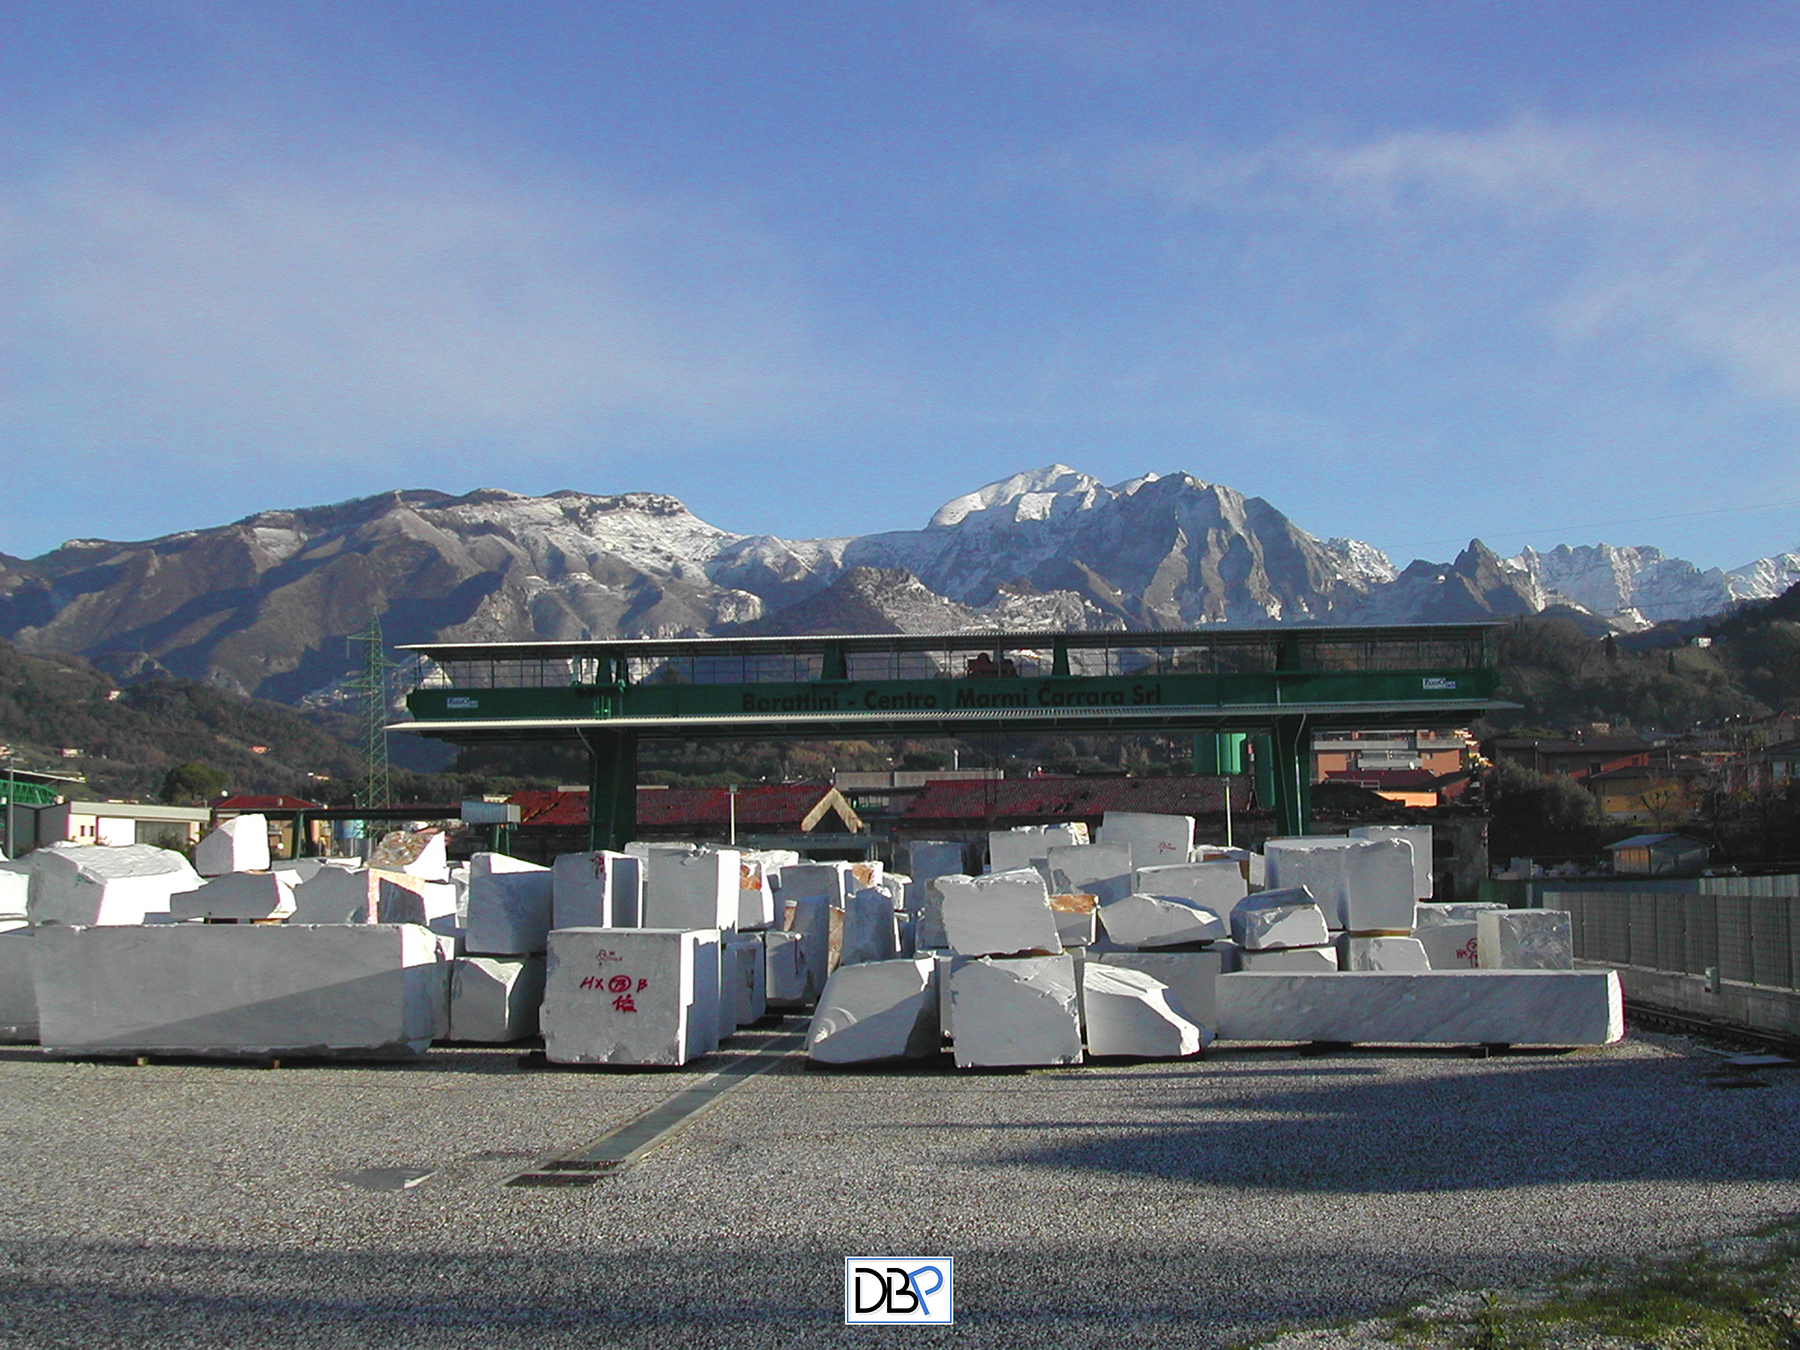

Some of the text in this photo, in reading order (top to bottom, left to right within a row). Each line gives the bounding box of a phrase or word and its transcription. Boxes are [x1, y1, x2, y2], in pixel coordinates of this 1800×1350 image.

[742, 690, 838, 712] Barattini
[864, 690, 937, 710] Centro
[955, 687, 1028, 708] Marmi
[1037, 686, 1125, 707] Carrara
[1132, 684, 1161, 705] Srl
